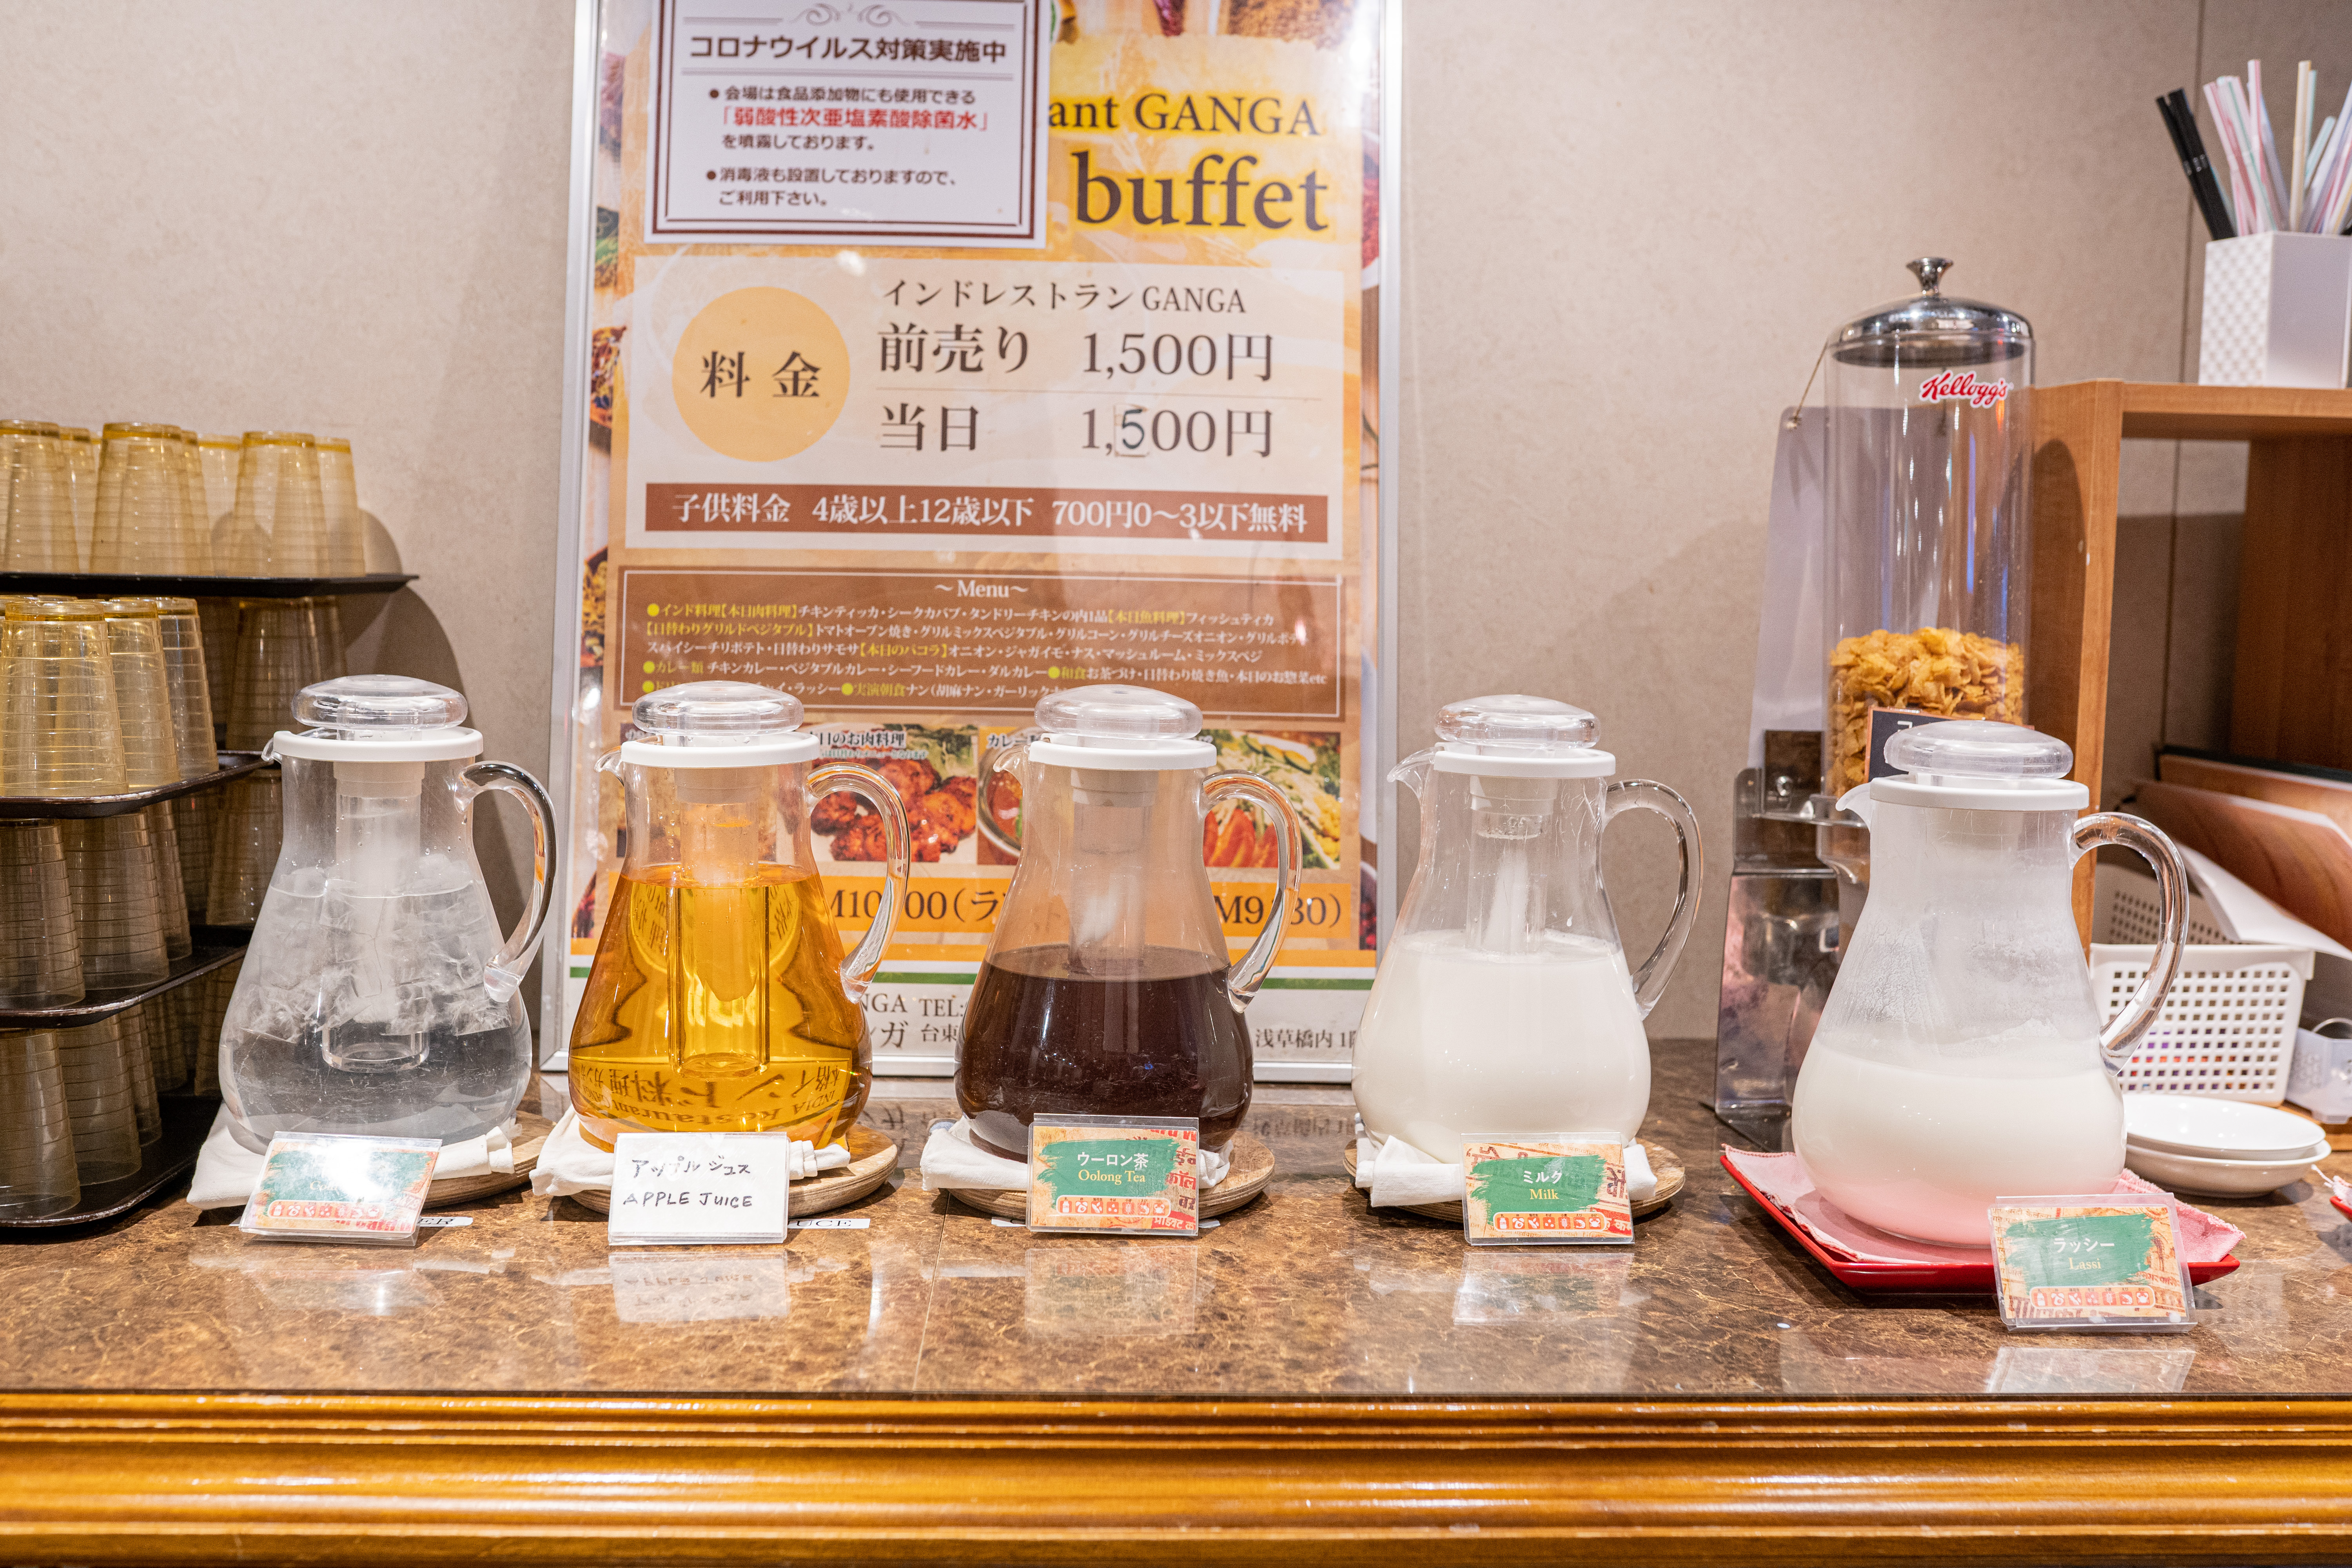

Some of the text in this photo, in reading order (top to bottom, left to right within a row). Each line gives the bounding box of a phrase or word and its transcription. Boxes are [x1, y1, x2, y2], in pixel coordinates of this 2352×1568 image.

[690, 36, 1006, 64] コロナウイルス対策実施中
[725, 86, 976, 104] 会場は食品添加物にも使用できる
[723, 106, 988, 131] 「弱酸性次亜塩素酸除菌水」
[1134, 93, 1320, 136] GANGA
[723, 134, 874, 151] を噴霧しております。
[720, 167, 956, 186] 消毒液も設置しておりますので、
[719, 189, 828, 206] ご利用下さい。
[1071, 151, 1328, 232] buffet
[883, 279, 1246, 313] インドレストラン GANGA
[877, 322, 1273, 382] 前売り 1,500円
[1922, 372, 2008, 405] Kellogg's
[880, 403, 1273, 458] 当日 1,500円
[672, 493, 791, 523] 子供料金
[812, 494, 1034, 526] 4歳以上12歳以下
[1256, 1029, 1333, 1049] 浅草橋内
[1077, 1151, 1149, 1169] ウーロン茶
[1078, 1169, 1146, 1185] Oolong Tea
[1523, 1171, 1563, 1184] ミルク
[622, 1192, 753, 1208] APPLE JUICE
[1529, 1188, 1559, 1200] Milk
[2054, 1238, 2115, 1253] ラッシー
[2069, 1257, 2102, 1270] Lassi
